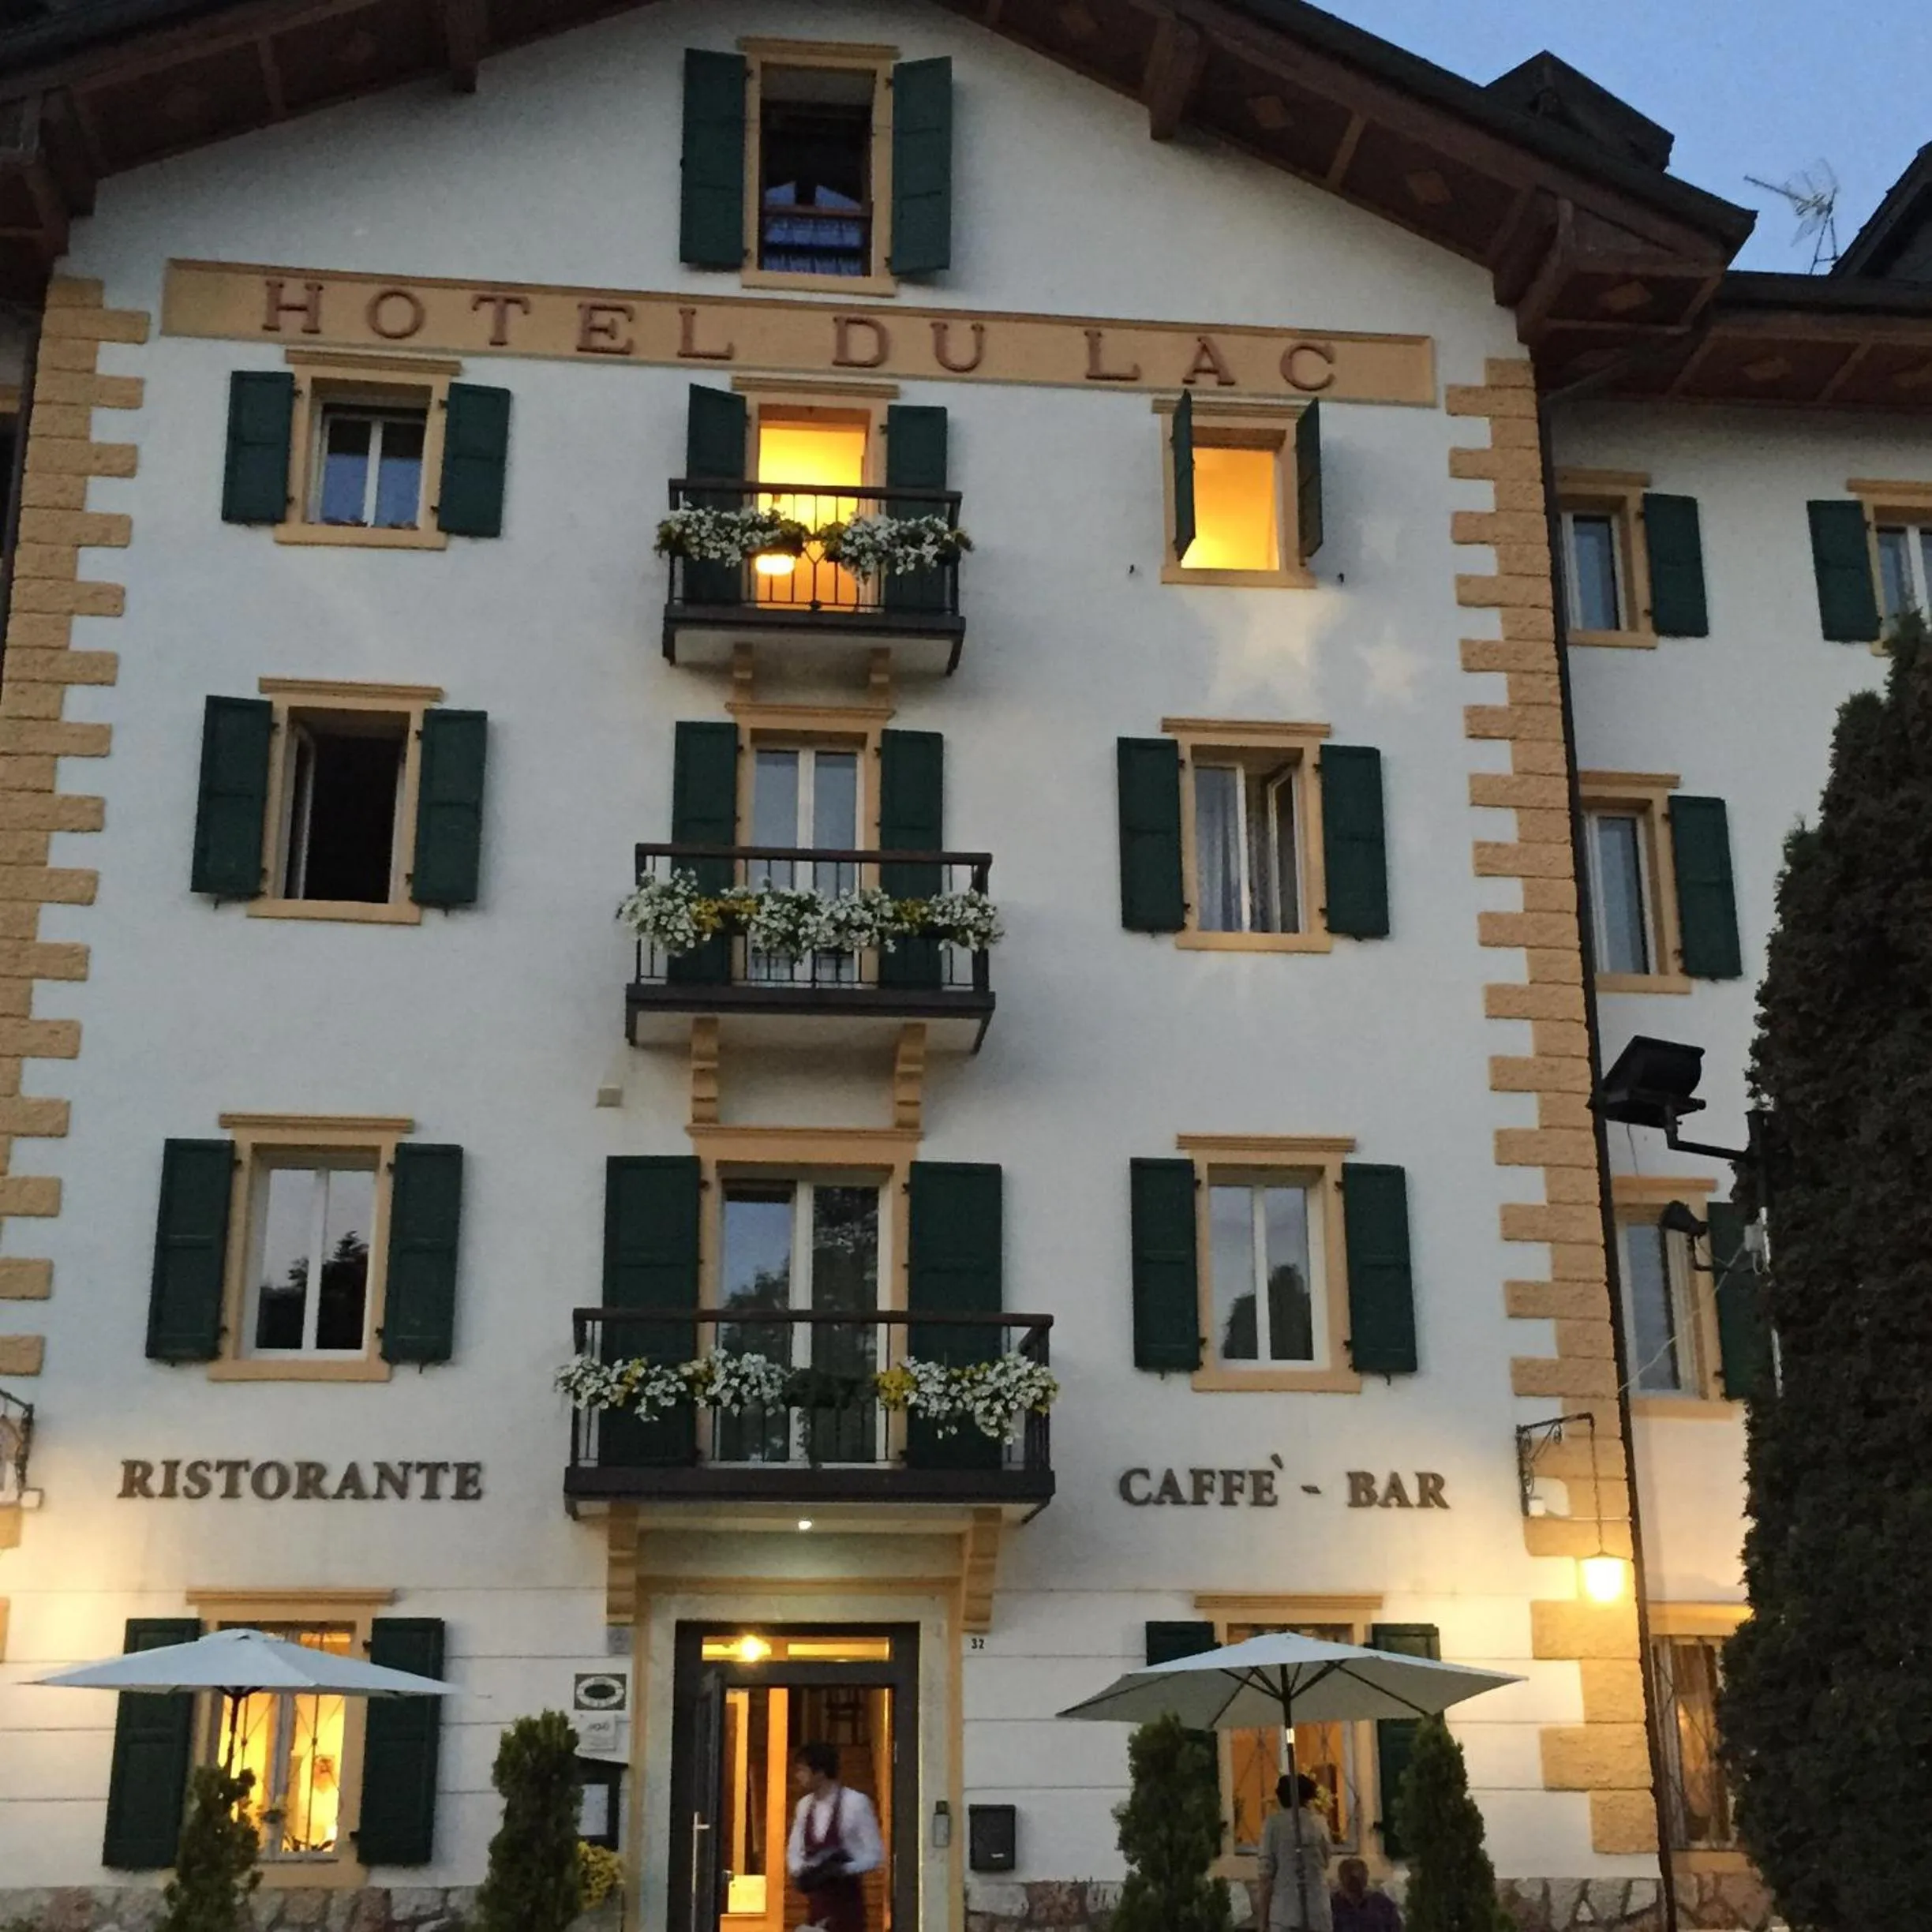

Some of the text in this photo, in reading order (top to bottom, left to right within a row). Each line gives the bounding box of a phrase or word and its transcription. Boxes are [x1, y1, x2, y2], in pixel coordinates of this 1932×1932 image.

[262, 280, 1336, 391] HOTEL DU LAC
[117, 1459, 483, 1500] RISTORANTE
[1346, 1470, 1451, 1509] BAR
[972, 1638, 985, 1649] 32
